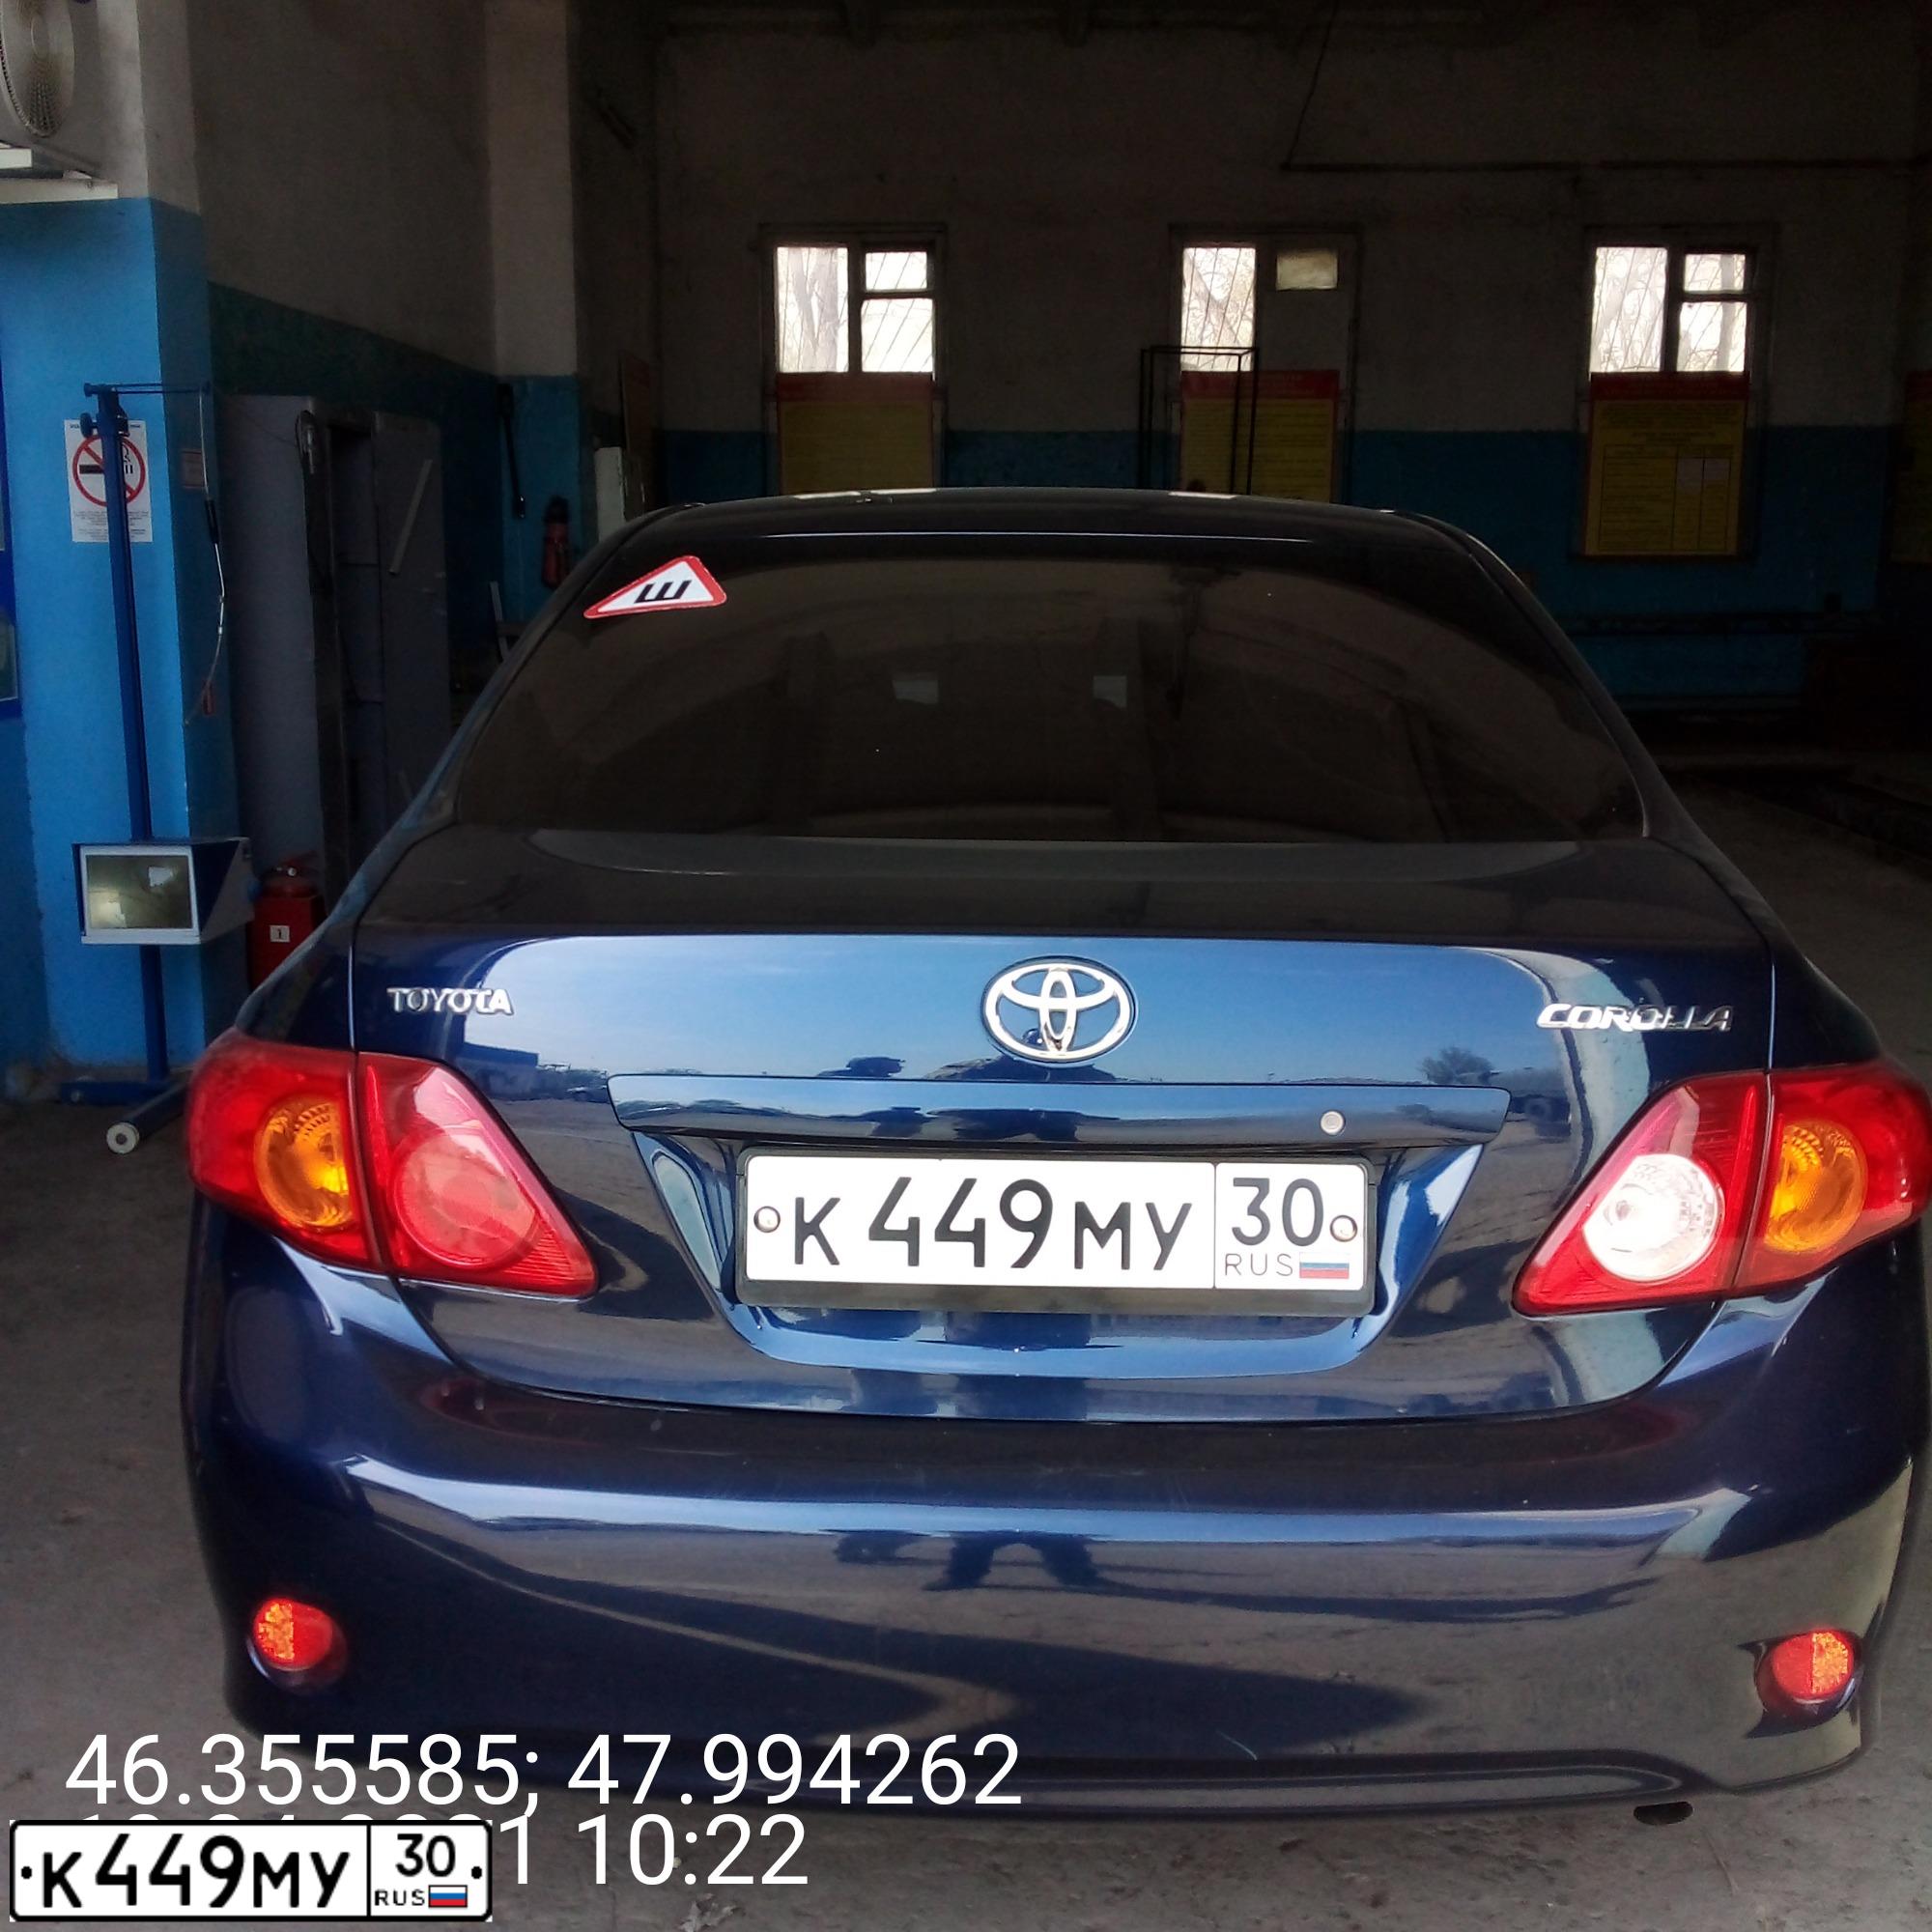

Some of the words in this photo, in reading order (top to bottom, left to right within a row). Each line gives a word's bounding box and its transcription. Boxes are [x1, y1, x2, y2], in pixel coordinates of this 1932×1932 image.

[634, 580, 692, 604] Ш
[386, 986, 514, 1015] TOYOTA
[1536, 1003, 1733, 1032] COROLLA
[1232, 1178, 1324, 1247] 30
[1224, 1252, 1293, 1277] RUS
